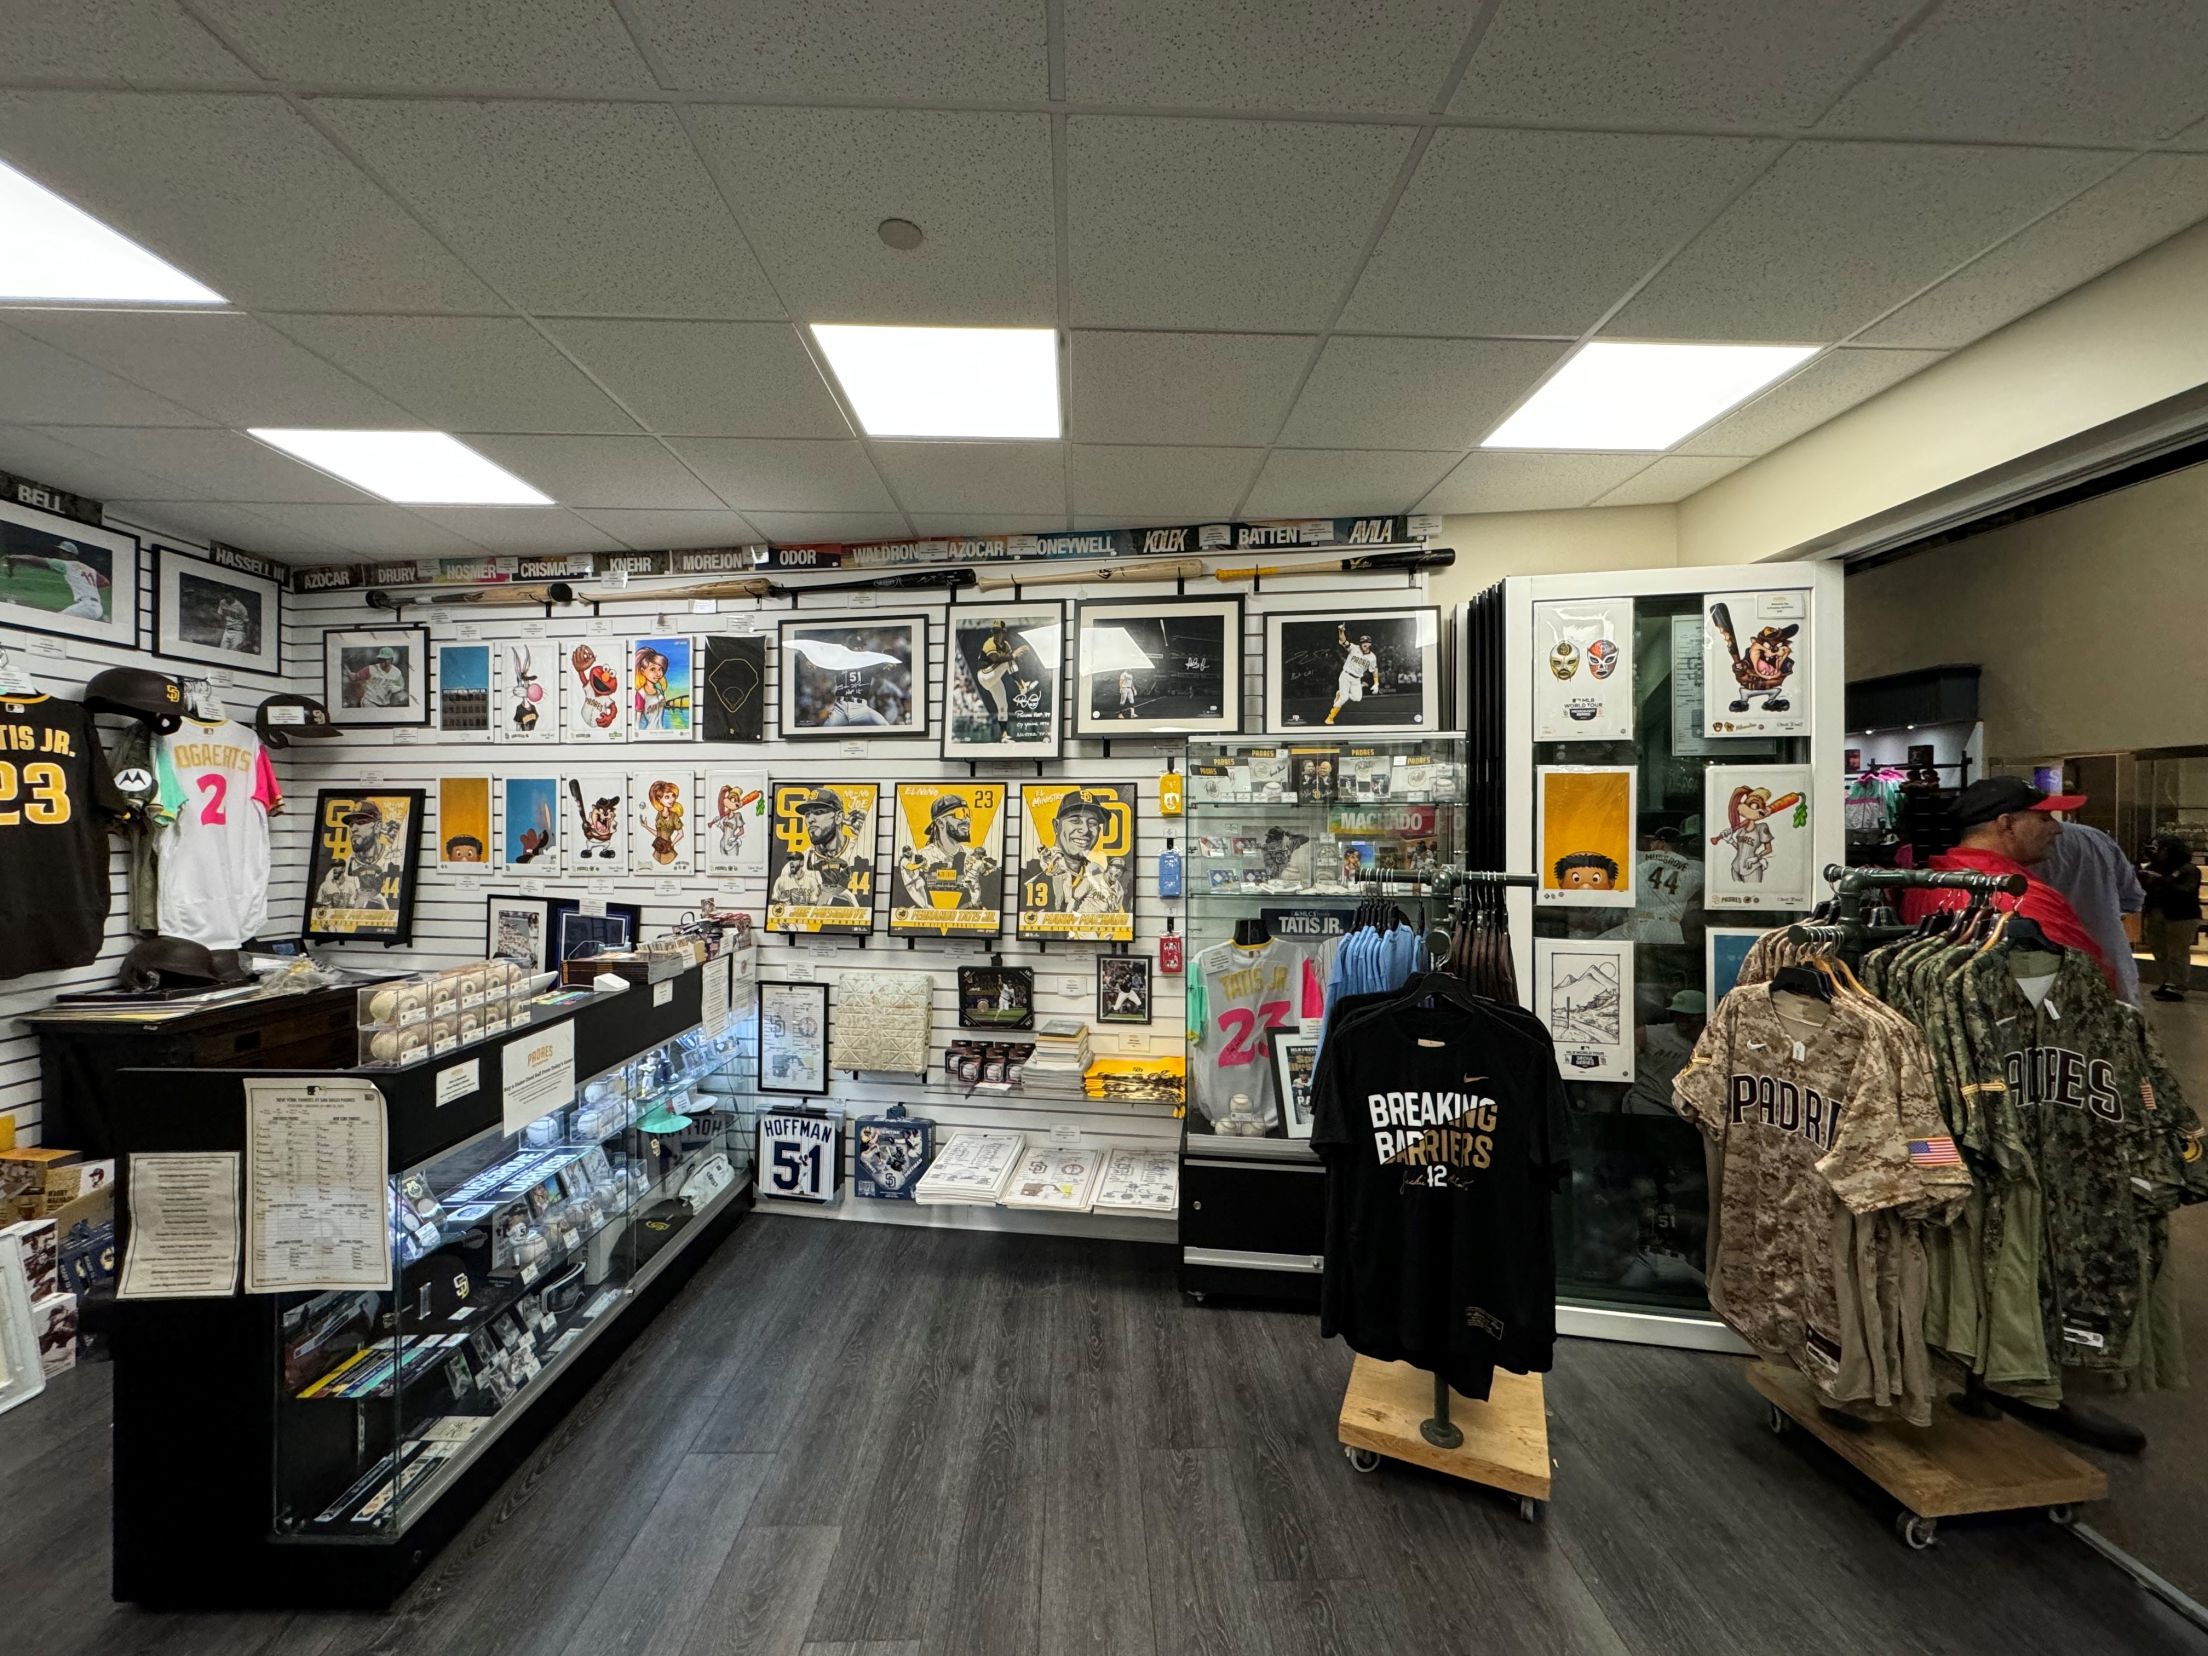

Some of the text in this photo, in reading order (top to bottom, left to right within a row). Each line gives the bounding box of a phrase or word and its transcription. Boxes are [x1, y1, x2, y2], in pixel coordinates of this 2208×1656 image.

[17, 483, 66, 515] BELL
[1238, 526, 1300, 545] BATTEN
[1349, 518, 1394, 544] AVILA
[852, 543, 920, 564] WALDRON
[948, 540, 1005, 558] AZOCAR
[1037, 535, 1116, 556] ONEYWELL
[215, 546, 272, 578] HASSELL
[609, 556, 652, 573] KNEHR
[682, 552, 743, 571] MOREJON
[779, 549, 817, 566] ODOR
[304, 570, 350, 590] AZOCAR
[377, 566, 417, 584] DRURY
[446, 563, 497, 580] HOSMER
[849, 671, 862, 683] 51
[0, 724, 77, 758] TIS JR.
[173, 743, 252, 773] OGAERTS
[1213, 757, 1235, 767] PADRES
[1251, 749, 1275, 758] PADRES
[1351, 748, 1375, 757] PADRES
[195, 773, 228, 827] 2
[974, 789, 994, 809] 23
[1340, 812, 1423, 831] MACHADO
[1645, 852, 1689, 873] MUSGROVE
[380, 876, 400, 899] 44
[847, 871, 870, 896] 44
[1647, 866, 1680, 895] 44
[1026, 881, 1049, 907] 13
[1278, 916, 1344, 934] TATIS JR.
[1218, 966, 1265, 1001] TATIS
[527, 1044, 553, 1067] PADRES
[1368, 1090, 1498, 1132] BREAKING
[763, 1118, 833, 1144] HOFFMAN
[1374, 1128, 1494, 1169] BARRIERS
[442, 1152, 544, 1202] MUSGROVE
[773, 1140, 822, 1194] 51
